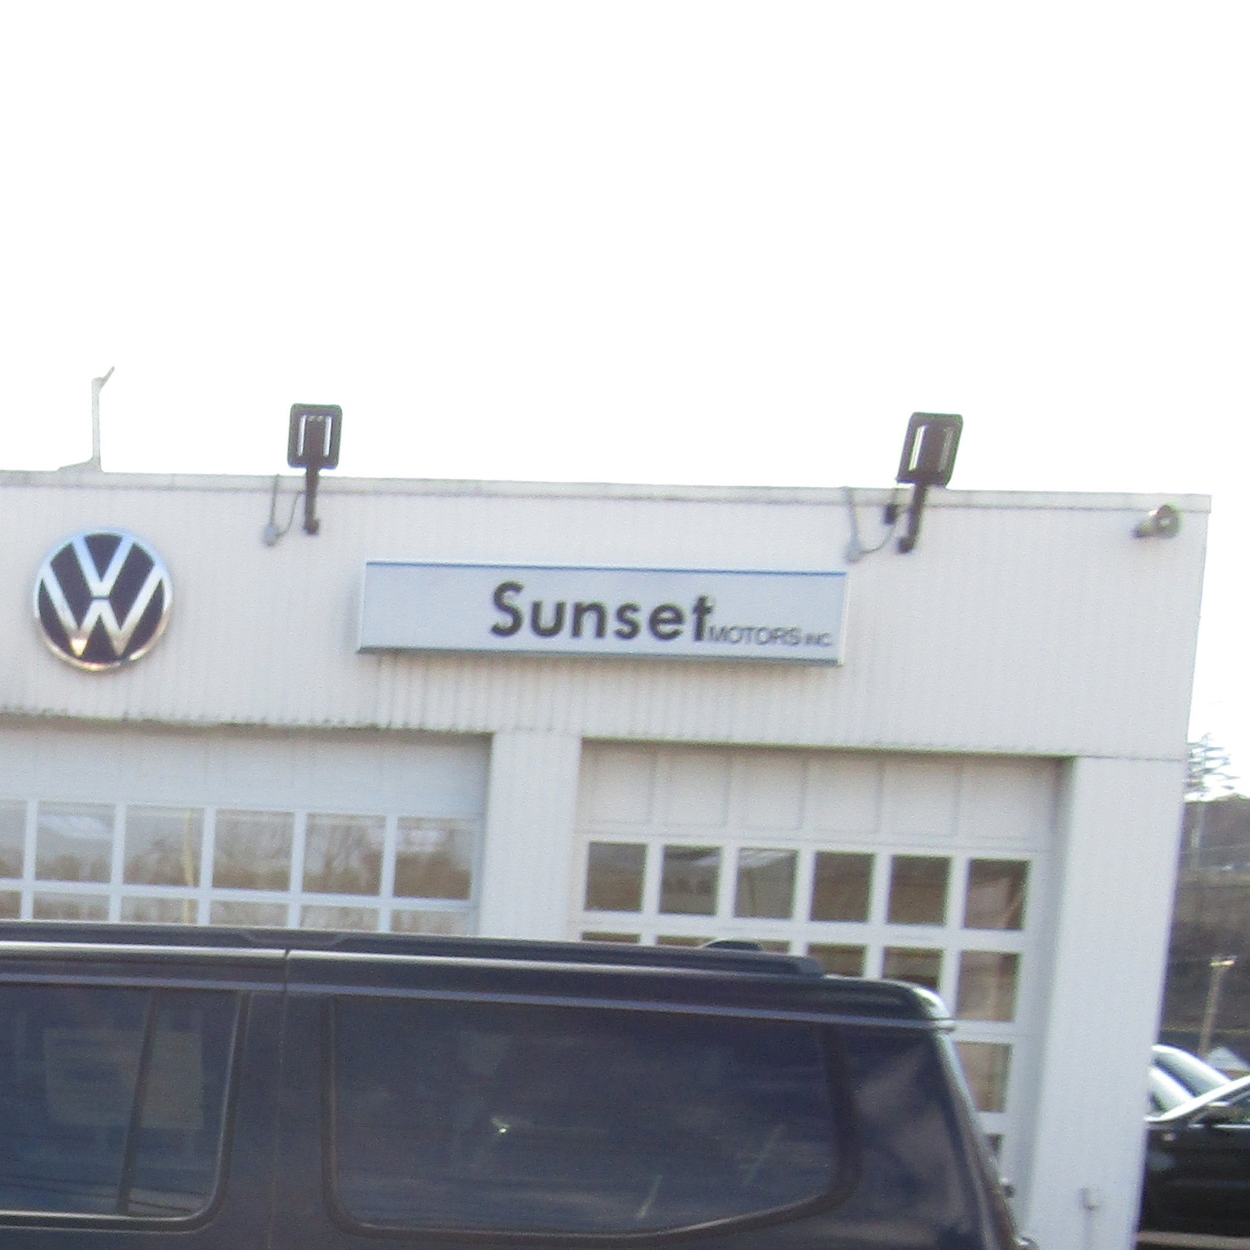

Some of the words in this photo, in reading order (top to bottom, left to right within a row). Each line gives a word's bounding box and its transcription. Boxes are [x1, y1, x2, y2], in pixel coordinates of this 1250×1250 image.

[36, 531, 170, 668] VW
[490, 580, 715, 642] Sunset
[708, 625, 802, 646] MOTORS
